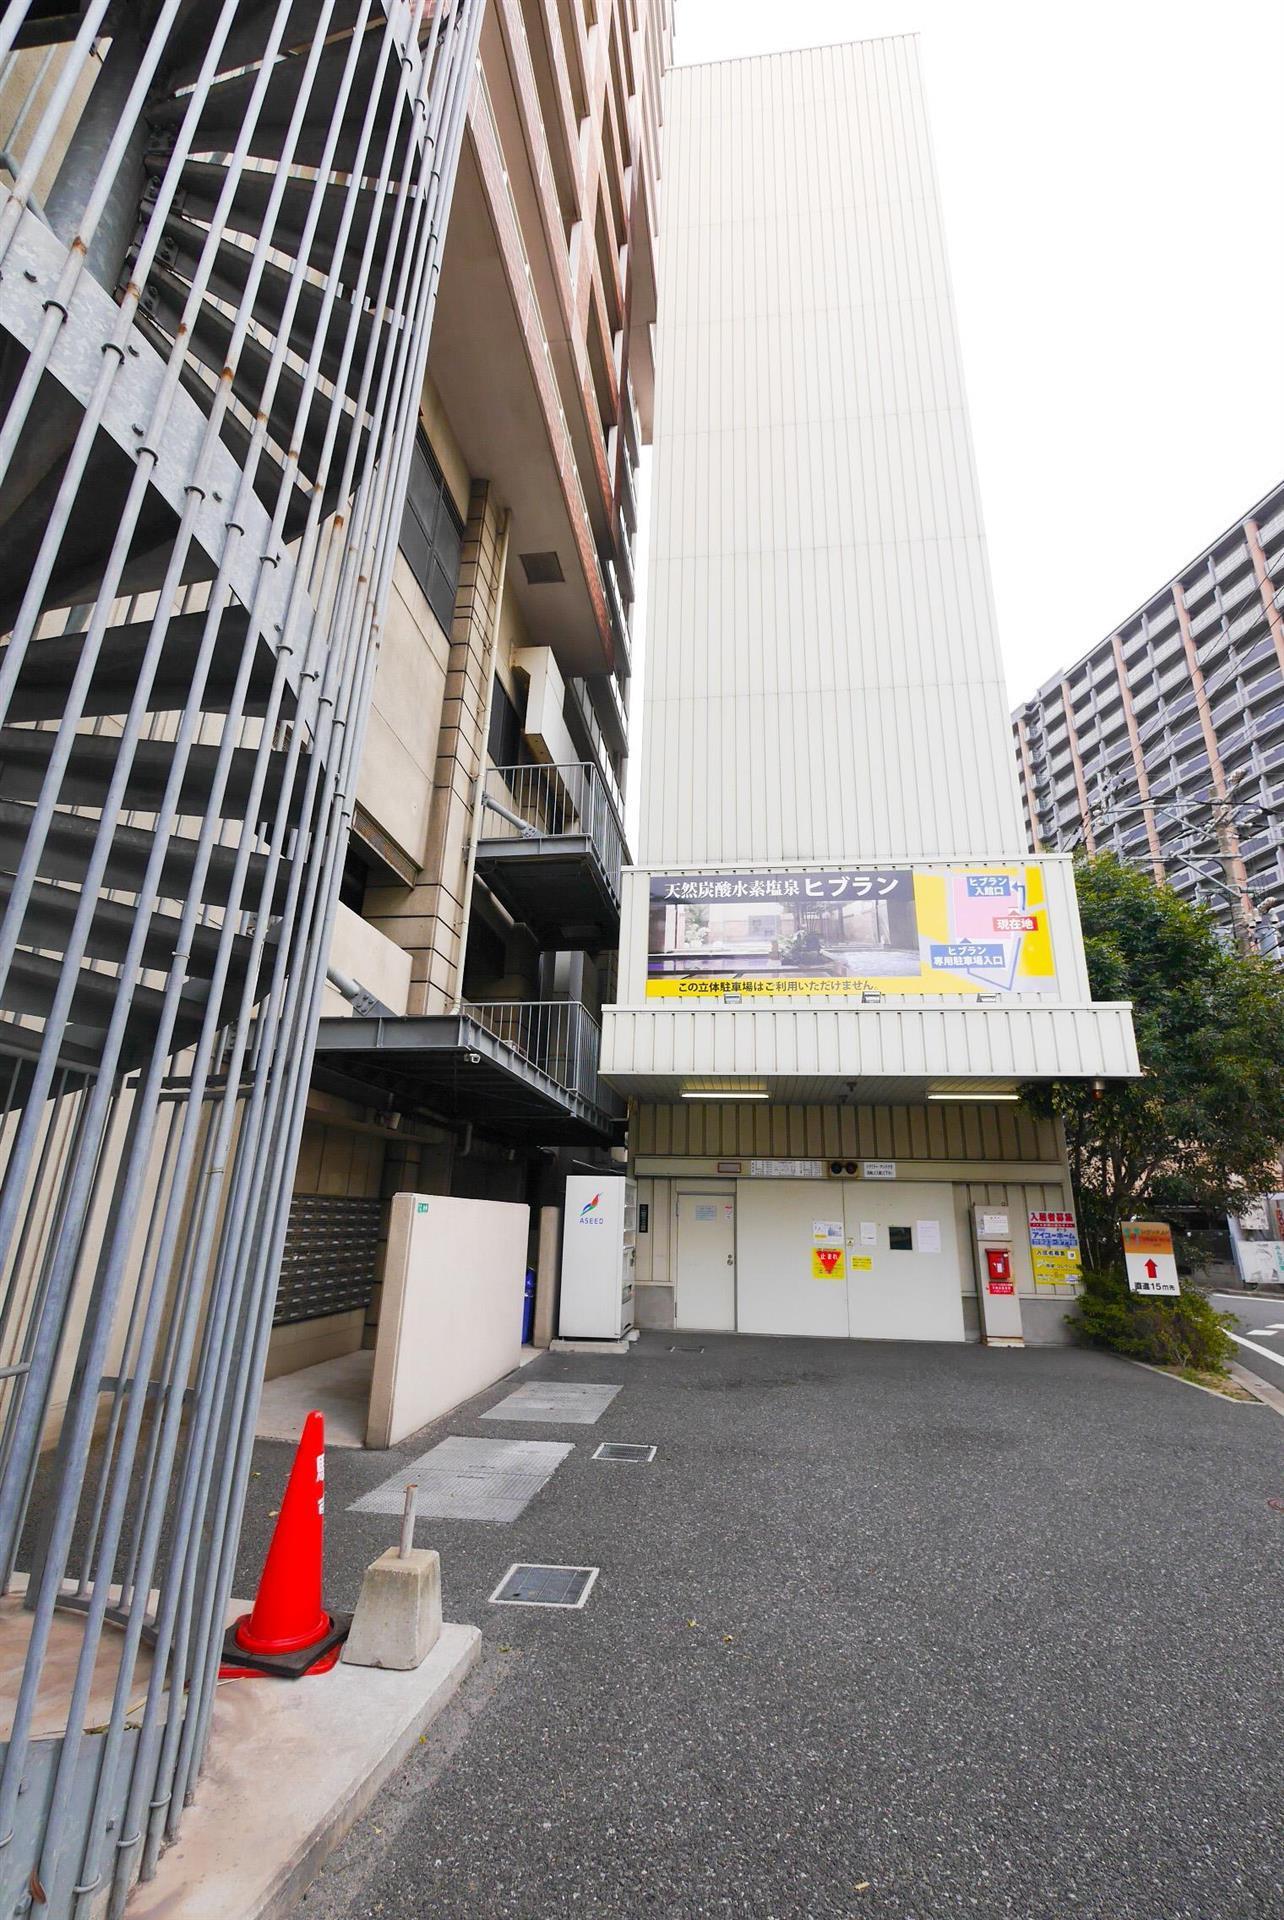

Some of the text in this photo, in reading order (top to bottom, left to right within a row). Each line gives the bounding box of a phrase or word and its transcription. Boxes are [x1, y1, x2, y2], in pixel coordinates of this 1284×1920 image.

[969, 877, 1008, 886] ヒブラン
[664, 876, 900, 899] 天然炭酸水素塩泉 ヒブラン
[975, 886, 1004, 896] 入館口
[996, 918, 1034, 930] 現在地
[948, 946, 987, 955] ヒブラン
[933, 956, 1003, 966] 専用駐車場入口
[678, 980, 878, 993] この立体駐車場はご利用いただけません。
[579, 1217, 604, 1225] ASEED
